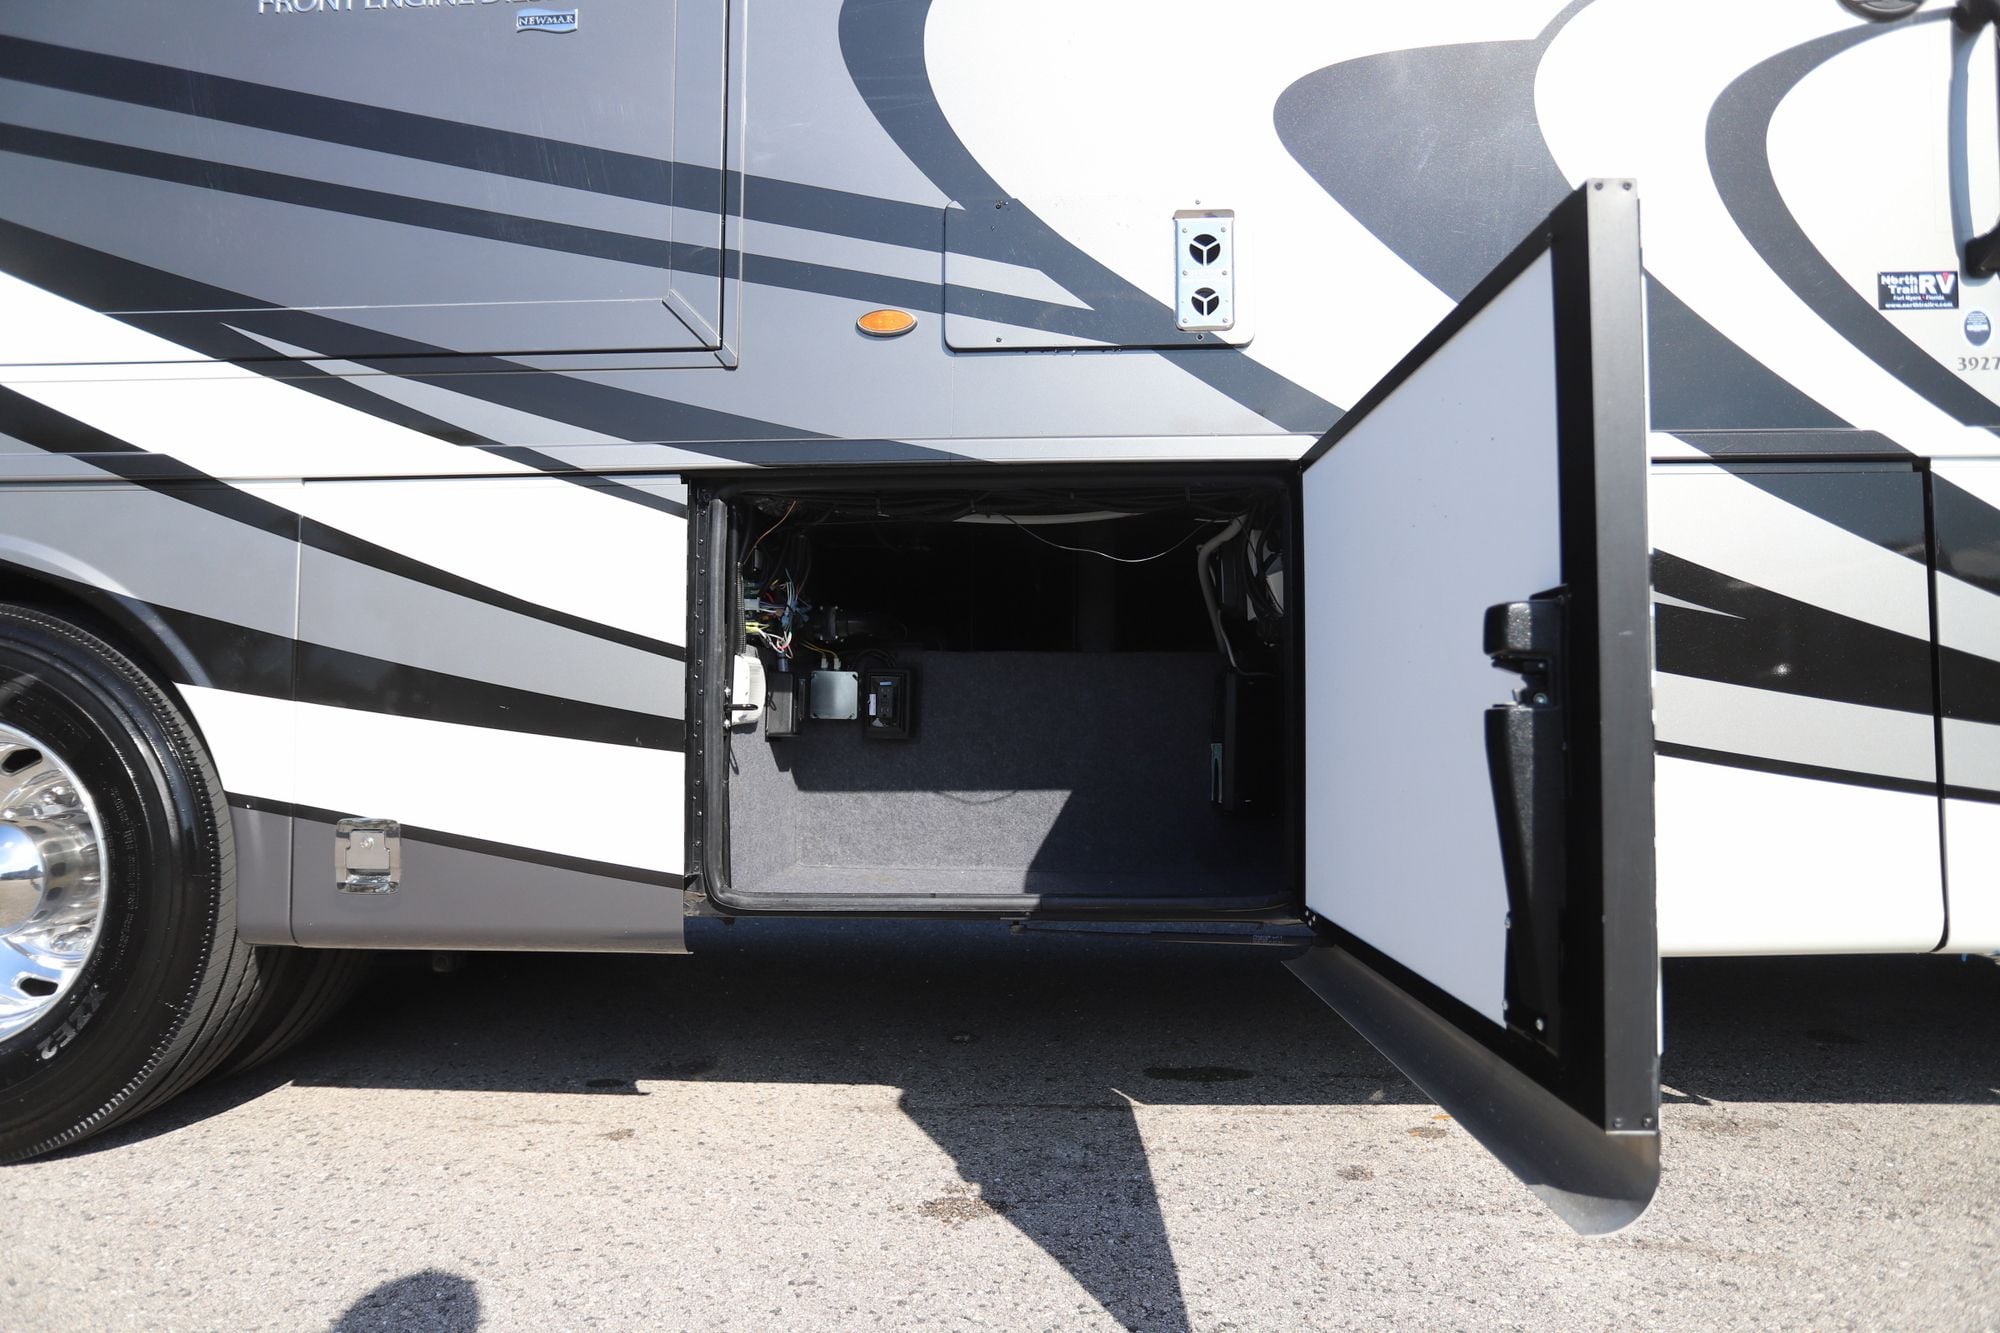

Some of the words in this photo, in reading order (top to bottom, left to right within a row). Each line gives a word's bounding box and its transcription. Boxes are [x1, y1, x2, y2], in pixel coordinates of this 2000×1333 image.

[519, 15, 574, 26] NEWMAR
[1881, 274, 1918, 285] North
[1919, 274, 1955, 294] RV
[1888, 284, 1918, 294] Trail
[1957, 356, 2000, 371] 3927
[36, 983, 109, 1060] XZE2
